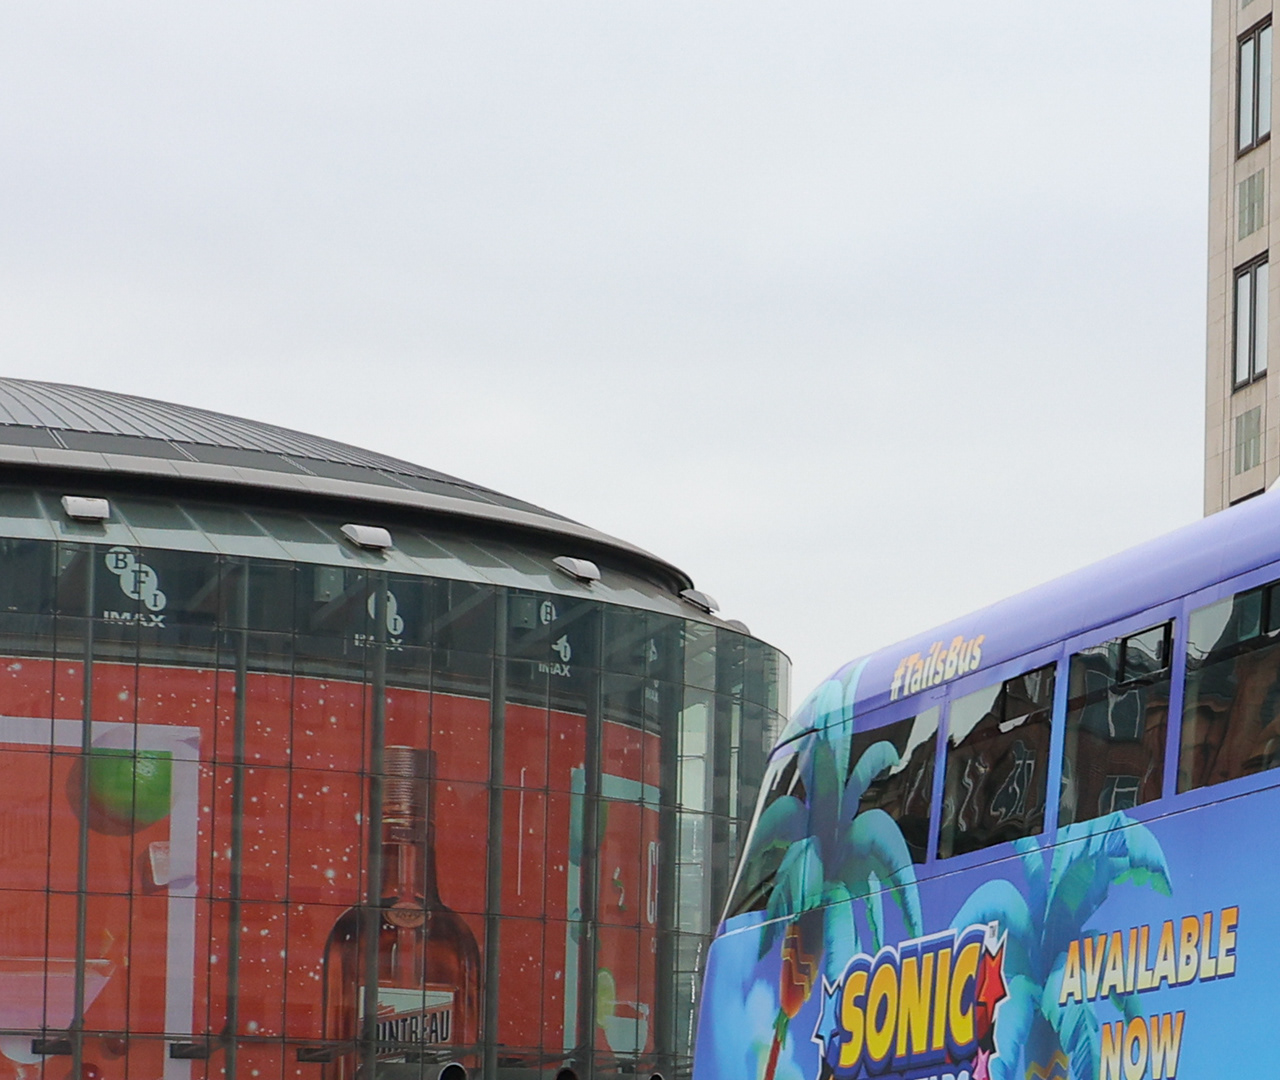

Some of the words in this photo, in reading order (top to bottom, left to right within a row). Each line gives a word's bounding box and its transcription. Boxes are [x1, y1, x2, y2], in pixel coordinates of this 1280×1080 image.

[890, 635, 985, 701] #TailsBus
[838, 942, 982, 1068] SONIC
[1058, 905, 1240, 1008] AVAILABLE
